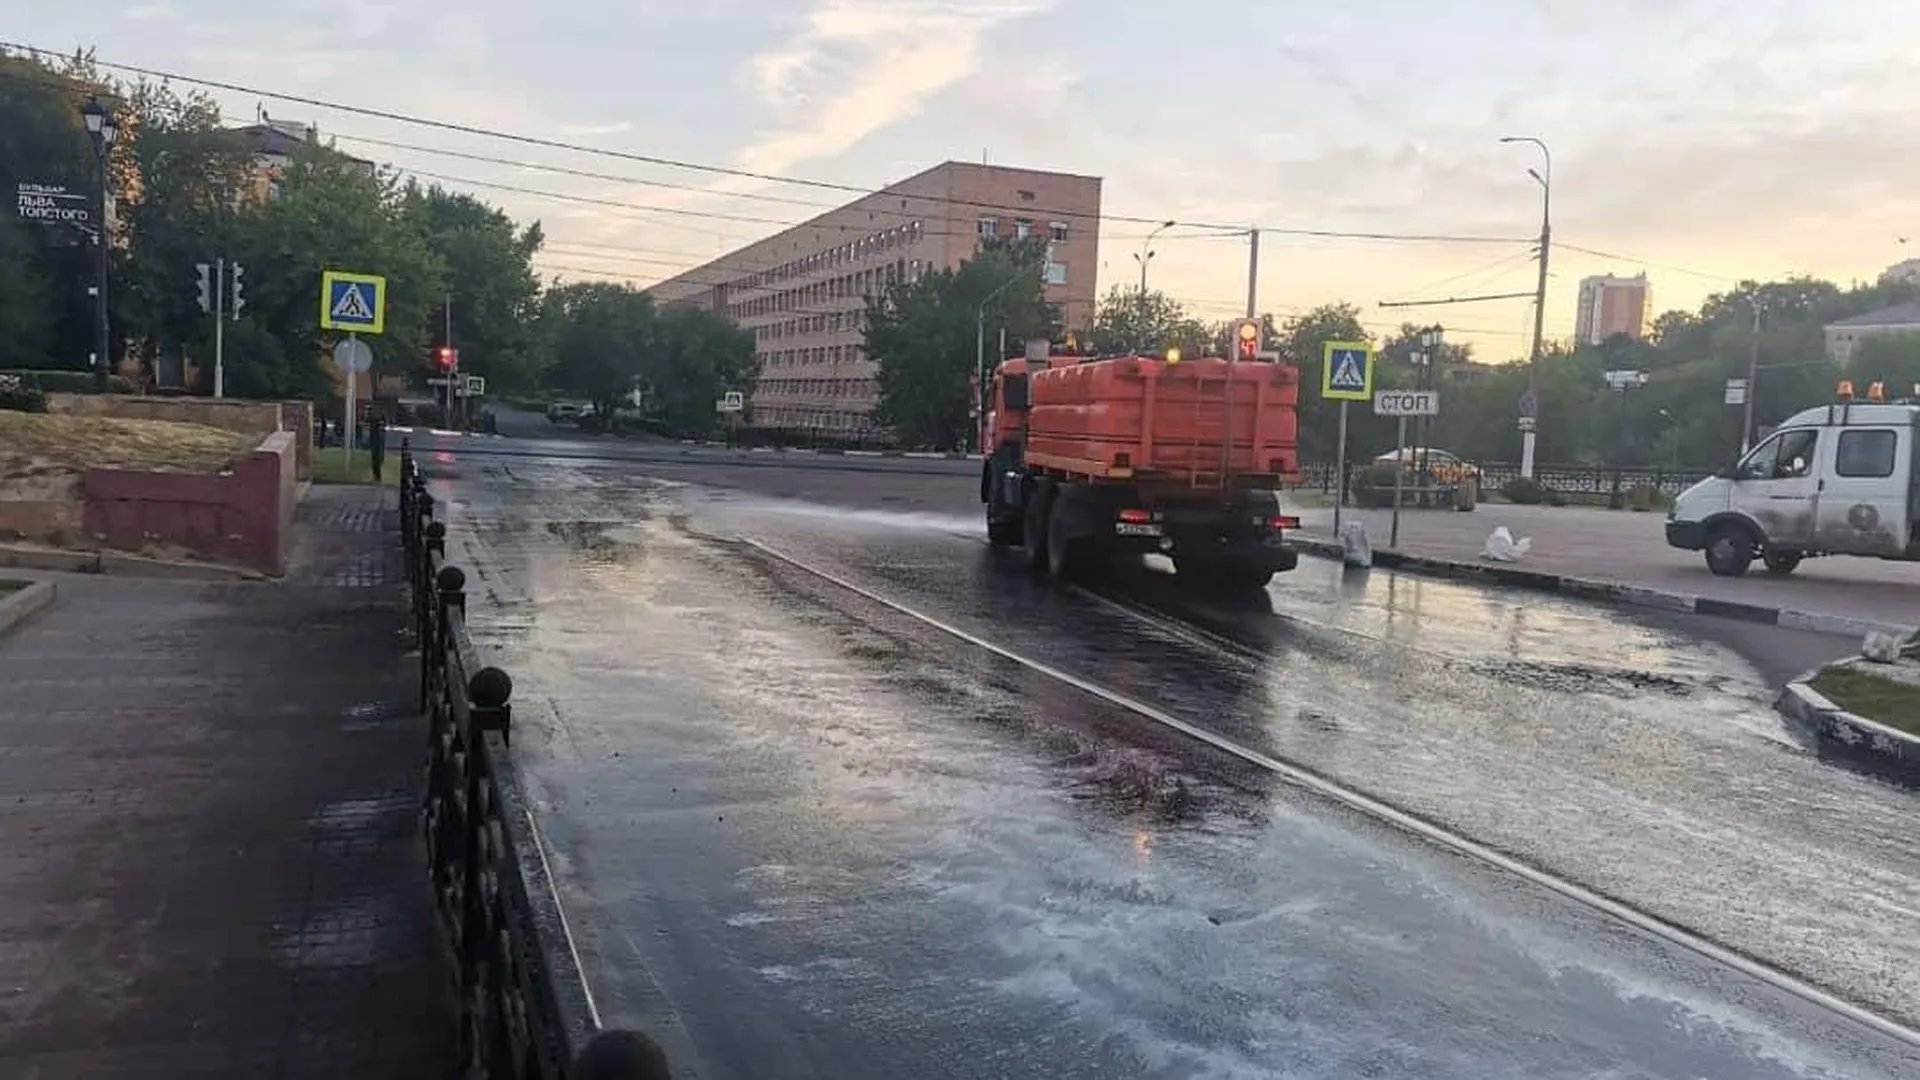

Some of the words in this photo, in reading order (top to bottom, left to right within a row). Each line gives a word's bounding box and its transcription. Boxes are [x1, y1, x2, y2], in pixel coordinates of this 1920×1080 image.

[18, 195, 56, 207] ЛЬВА
[18, 206, 89, 221] ТОЛСТОГО
[1380, 394, 1429, 411] СТОП
